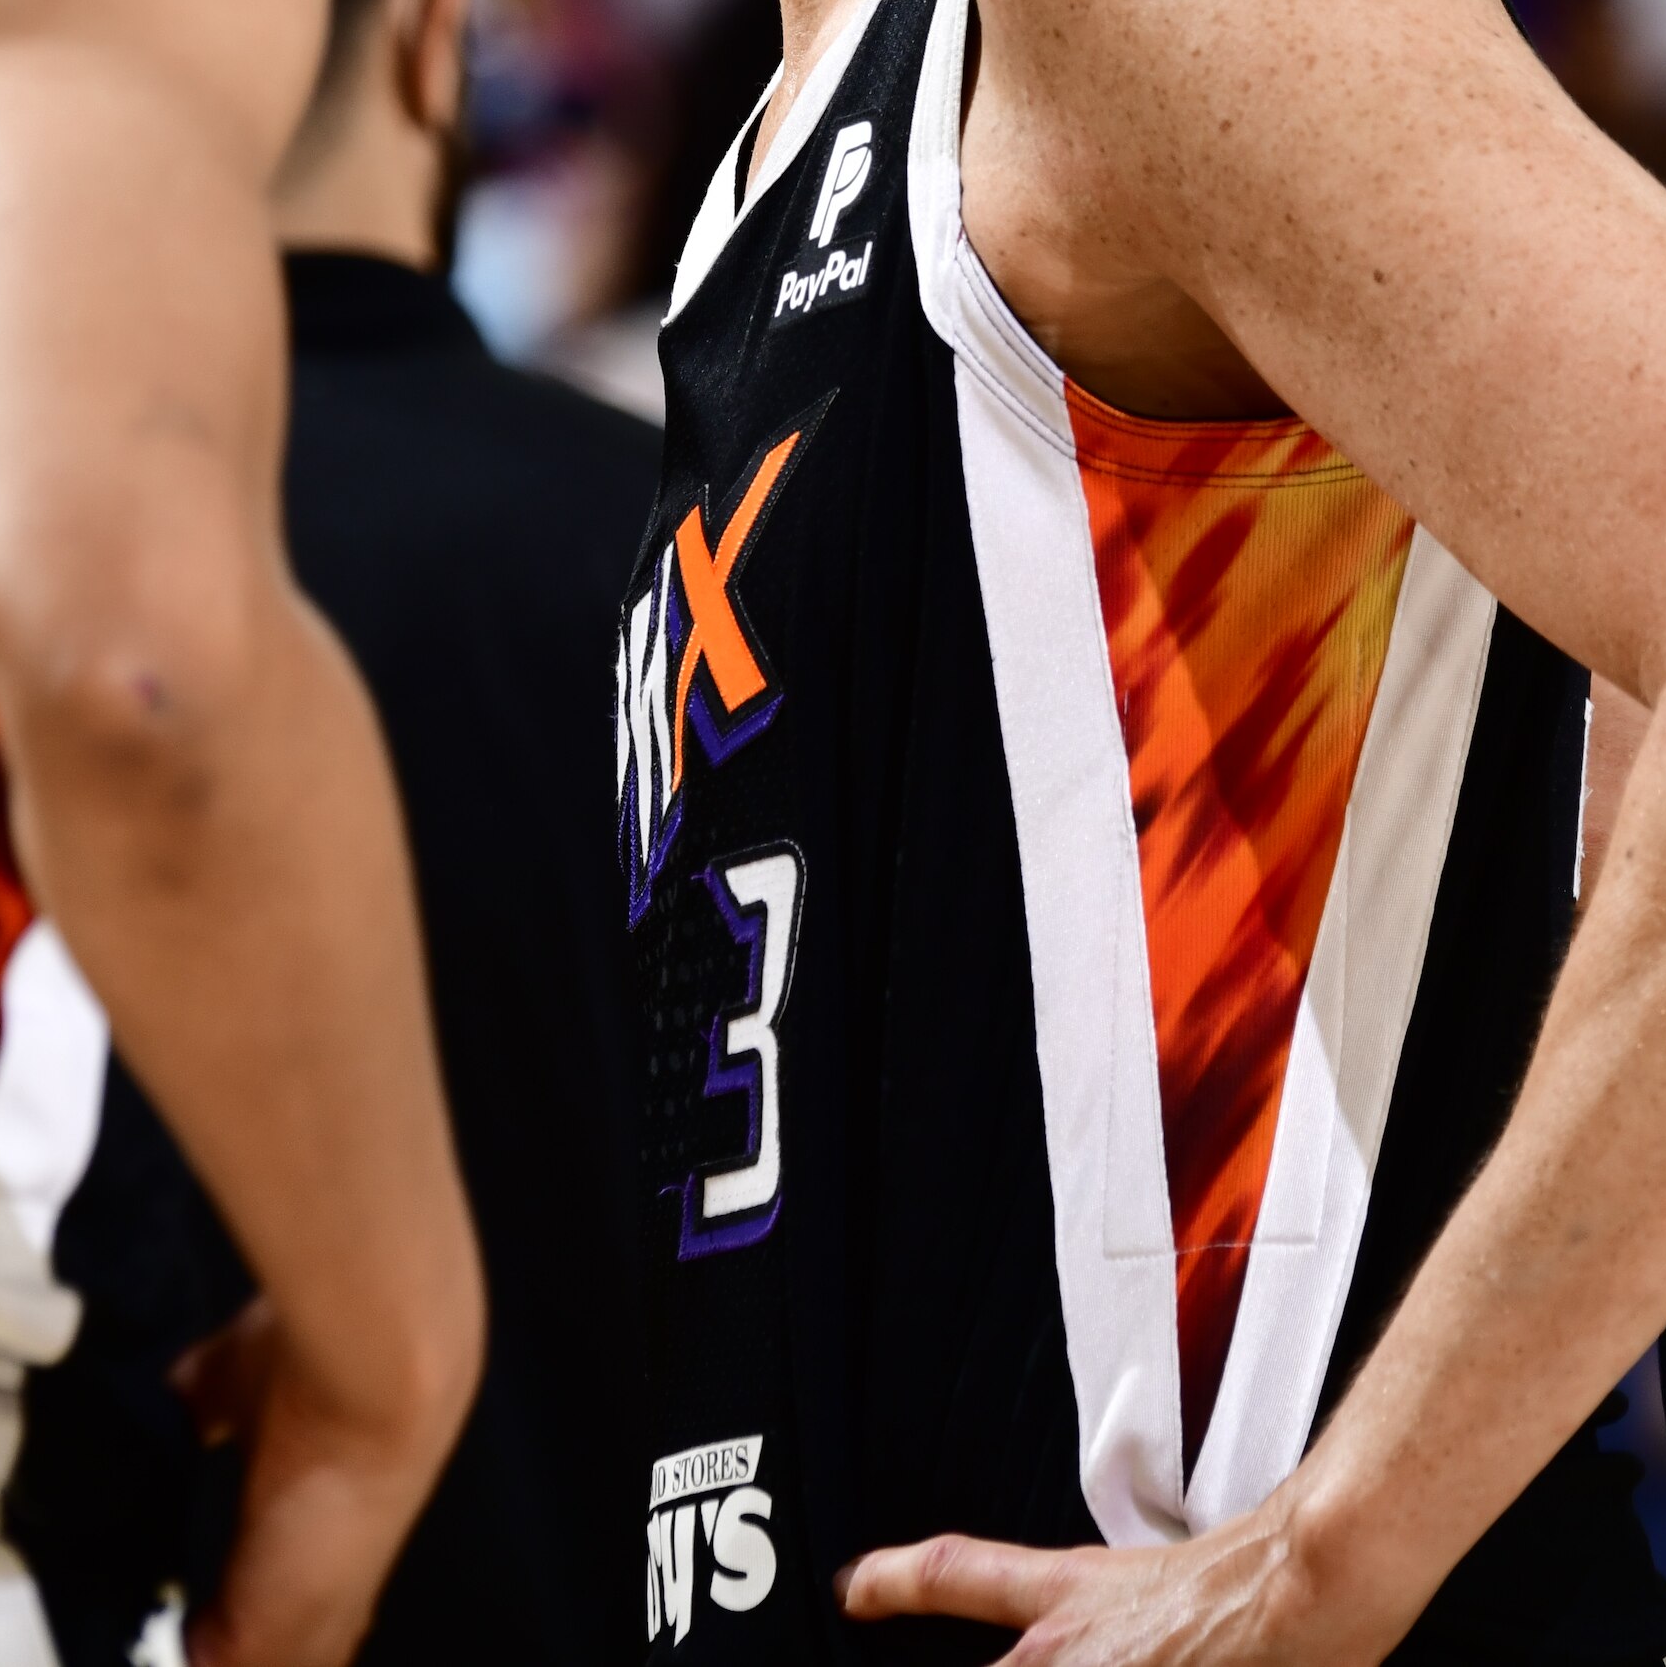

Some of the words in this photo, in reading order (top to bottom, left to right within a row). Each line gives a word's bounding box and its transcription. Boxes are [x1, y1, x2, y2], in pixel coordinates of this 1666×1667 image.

[774, 240, 874, 318] PayPal
[691, 848, 801, 1239] 3
[672, 1444, 750, 1494] STORES
